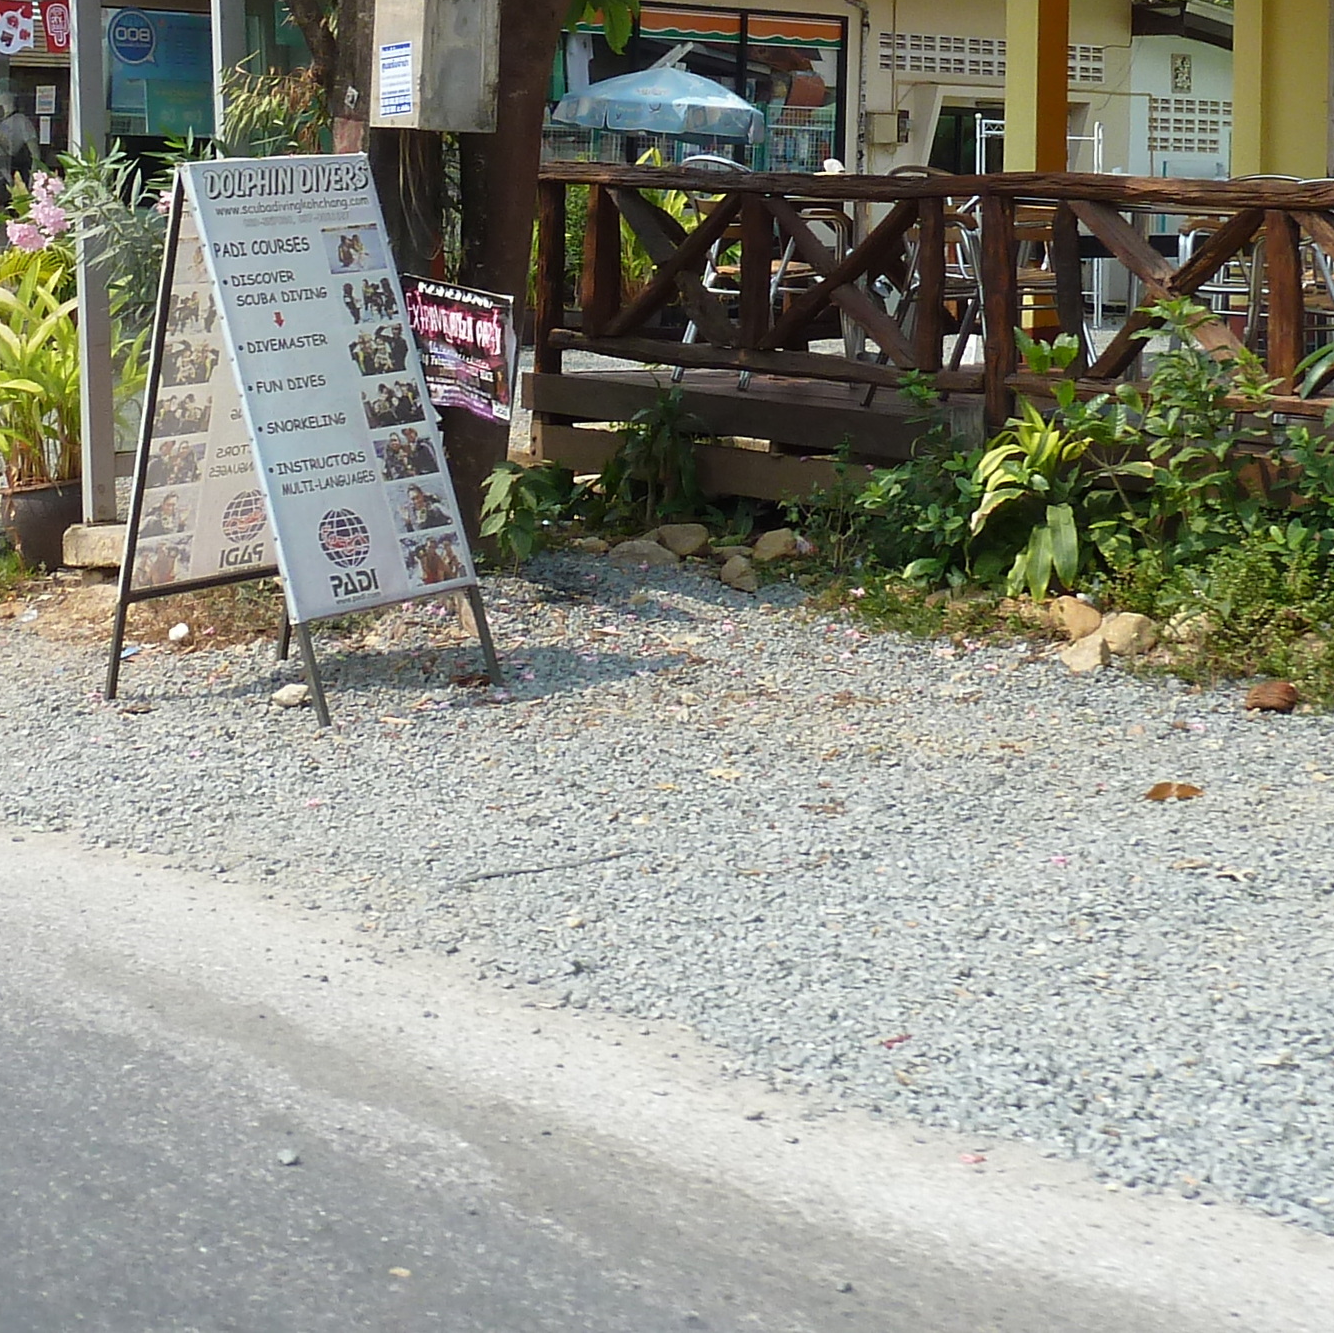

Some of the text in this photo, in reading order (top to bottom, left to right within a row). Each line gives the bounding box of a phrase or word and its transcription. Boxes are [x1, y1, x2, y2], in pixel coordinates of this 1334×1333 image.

[203, 160, 370, 200] DOLPHIN DIVERS
[214, 236, 310, 260] PADI COURSES
[231, 270, 296, 287] DISCOVER
[236, 286, 328, 307] SCUBA DIVING
[247, 333, 328, 354] DIVEMASTER
[256, 375, 326, 395] FUN DIVES
[267, 412, 347, 435] SNORKELING
[276, 450, 367, 475] INSTRUCTORS
[282, 469, 376, 496] MULTI-LANGUAGES
[329, 568, 380, 598] PADI
